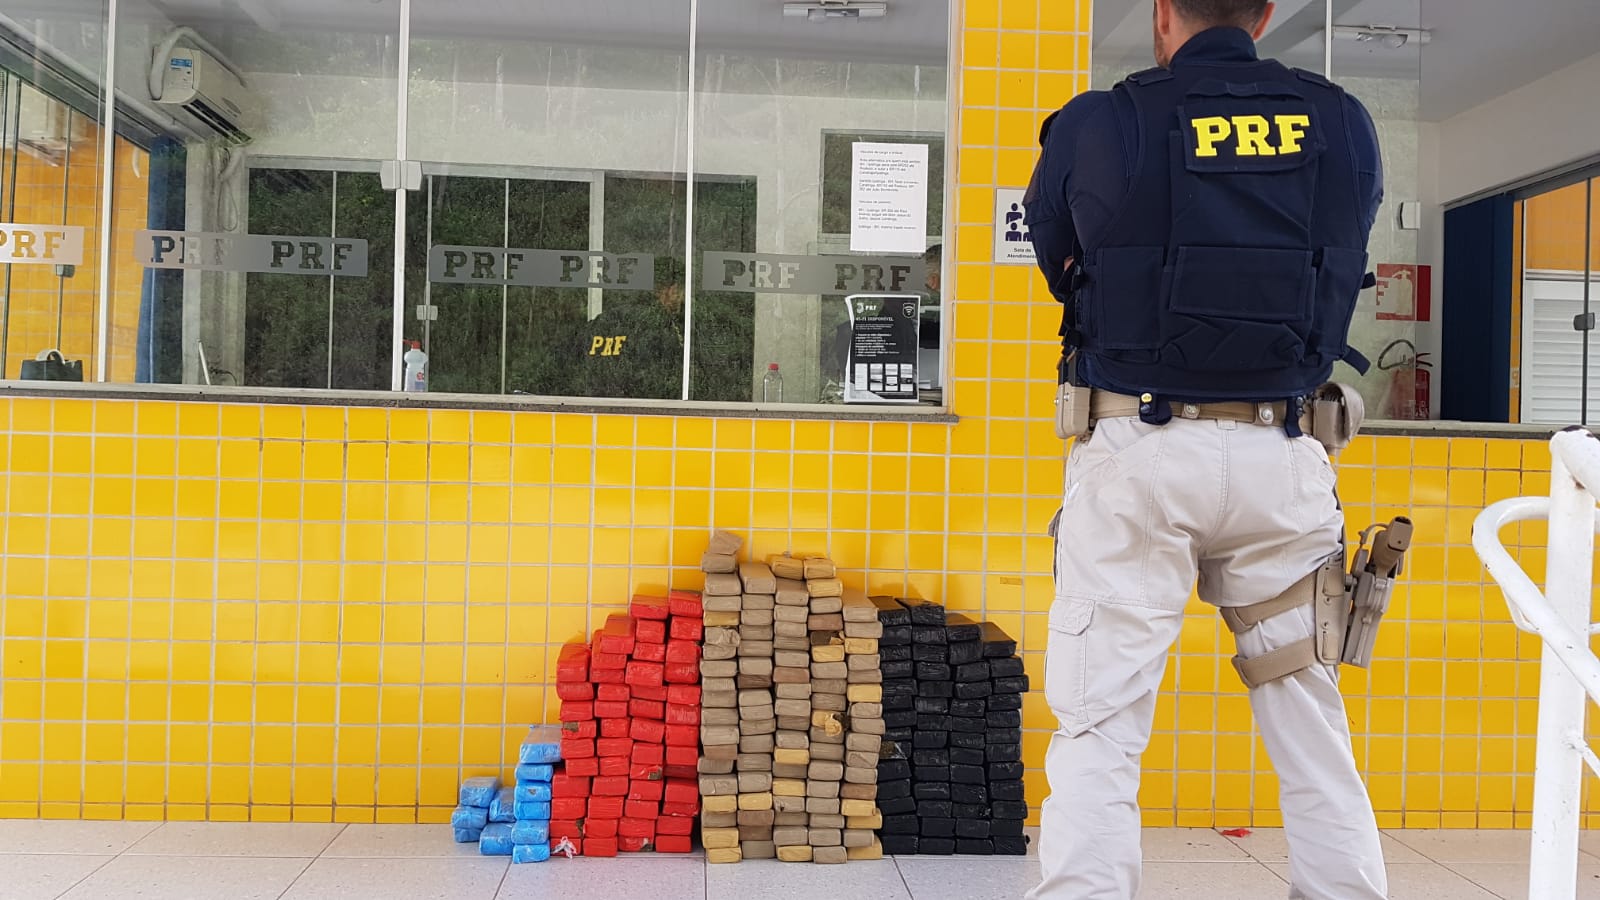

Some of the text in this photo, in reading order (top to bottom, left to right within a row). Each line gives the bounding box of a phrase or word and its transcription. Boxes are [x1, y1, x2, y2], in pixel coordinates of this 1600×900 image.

[1191, 114, 1310, 157] PRF
[270, 240, 353, 271] PRF
[443, 250, 638, 284] PRF PRF
[722, 259, 911, 291] PRF PRF
[589, 335, 627, 356] PRF
